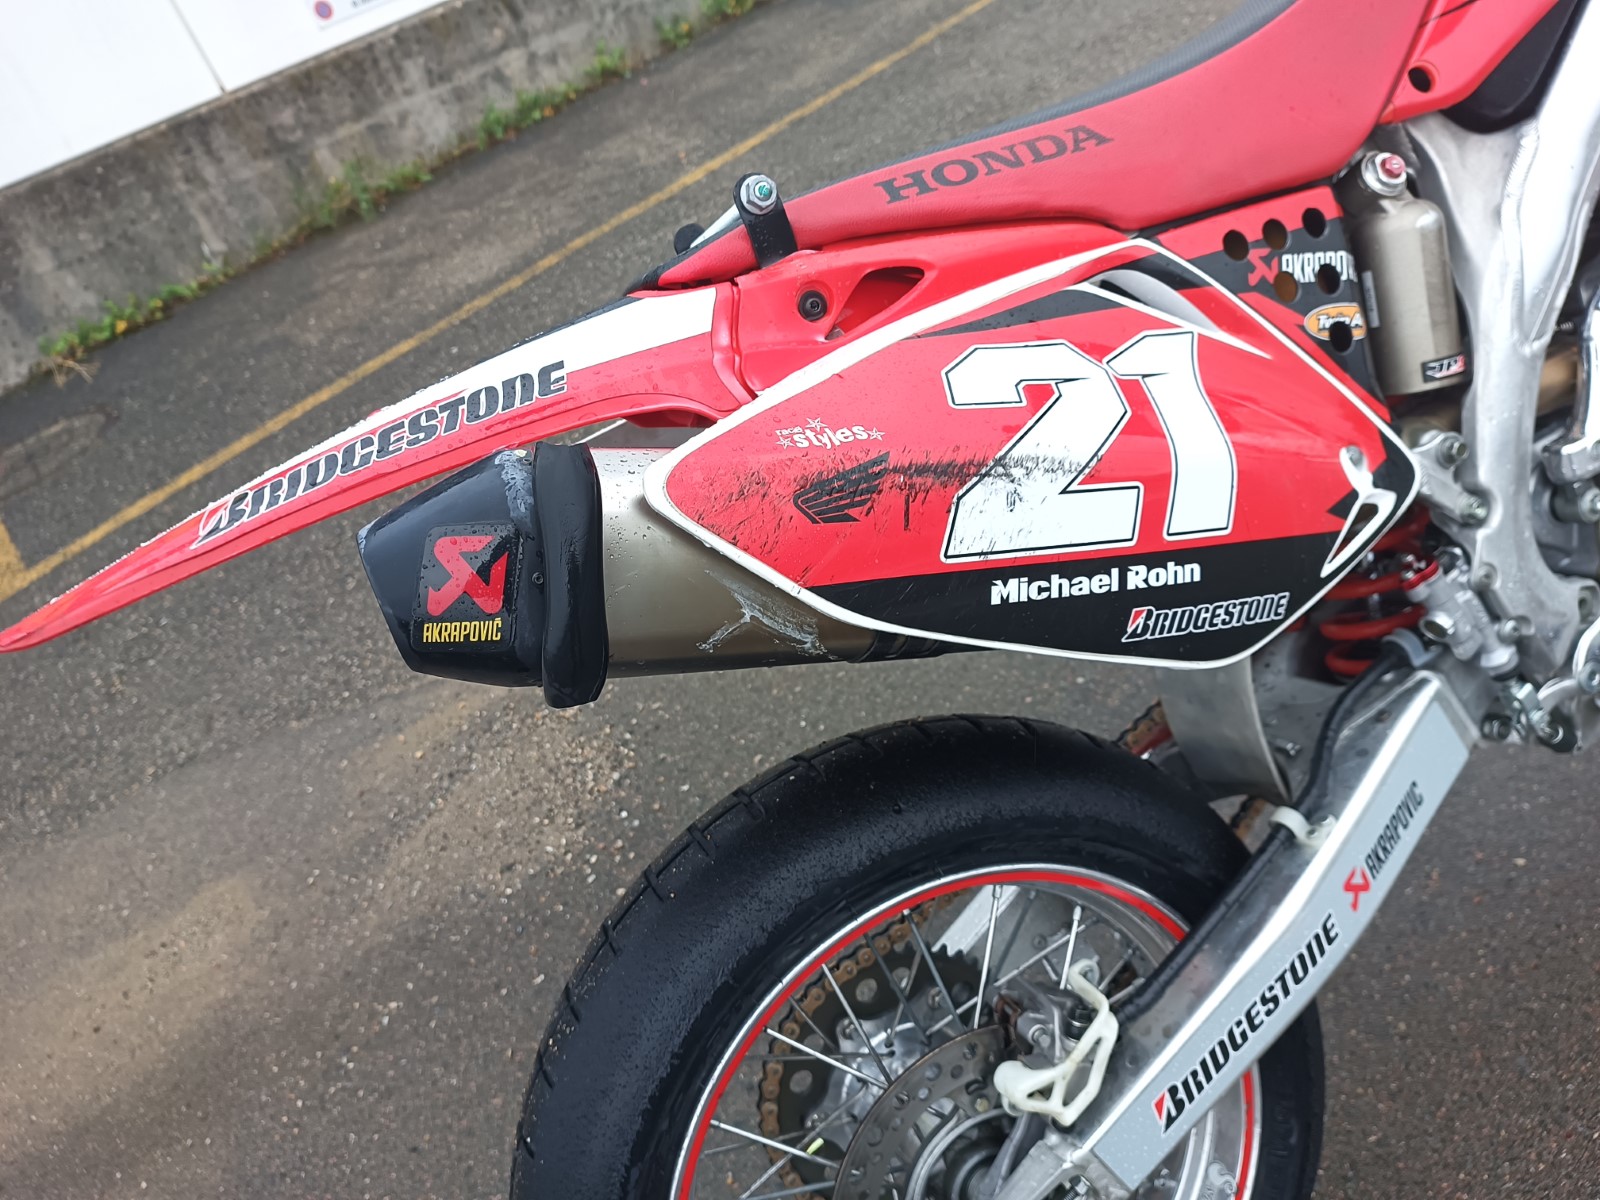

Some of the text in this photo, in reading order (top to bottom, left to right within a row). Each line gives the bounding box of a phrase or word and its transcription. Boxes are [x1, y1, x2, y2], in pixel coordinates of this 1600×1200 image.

[874, 125, 1114, 204] HONDA
[191, 360, 567, 549] BRIDGESTONE
[775, 426, 803, 436] race
[793, 425, 869, 450] styles
[940, 330, 1238, 563] 21
[990, 562, 1201, 605] Michael Rohn
[1121, 592, 1290, 642] BRIDGESTONE
[1153, 912, 1341, 1134] BRIDGESTONE
